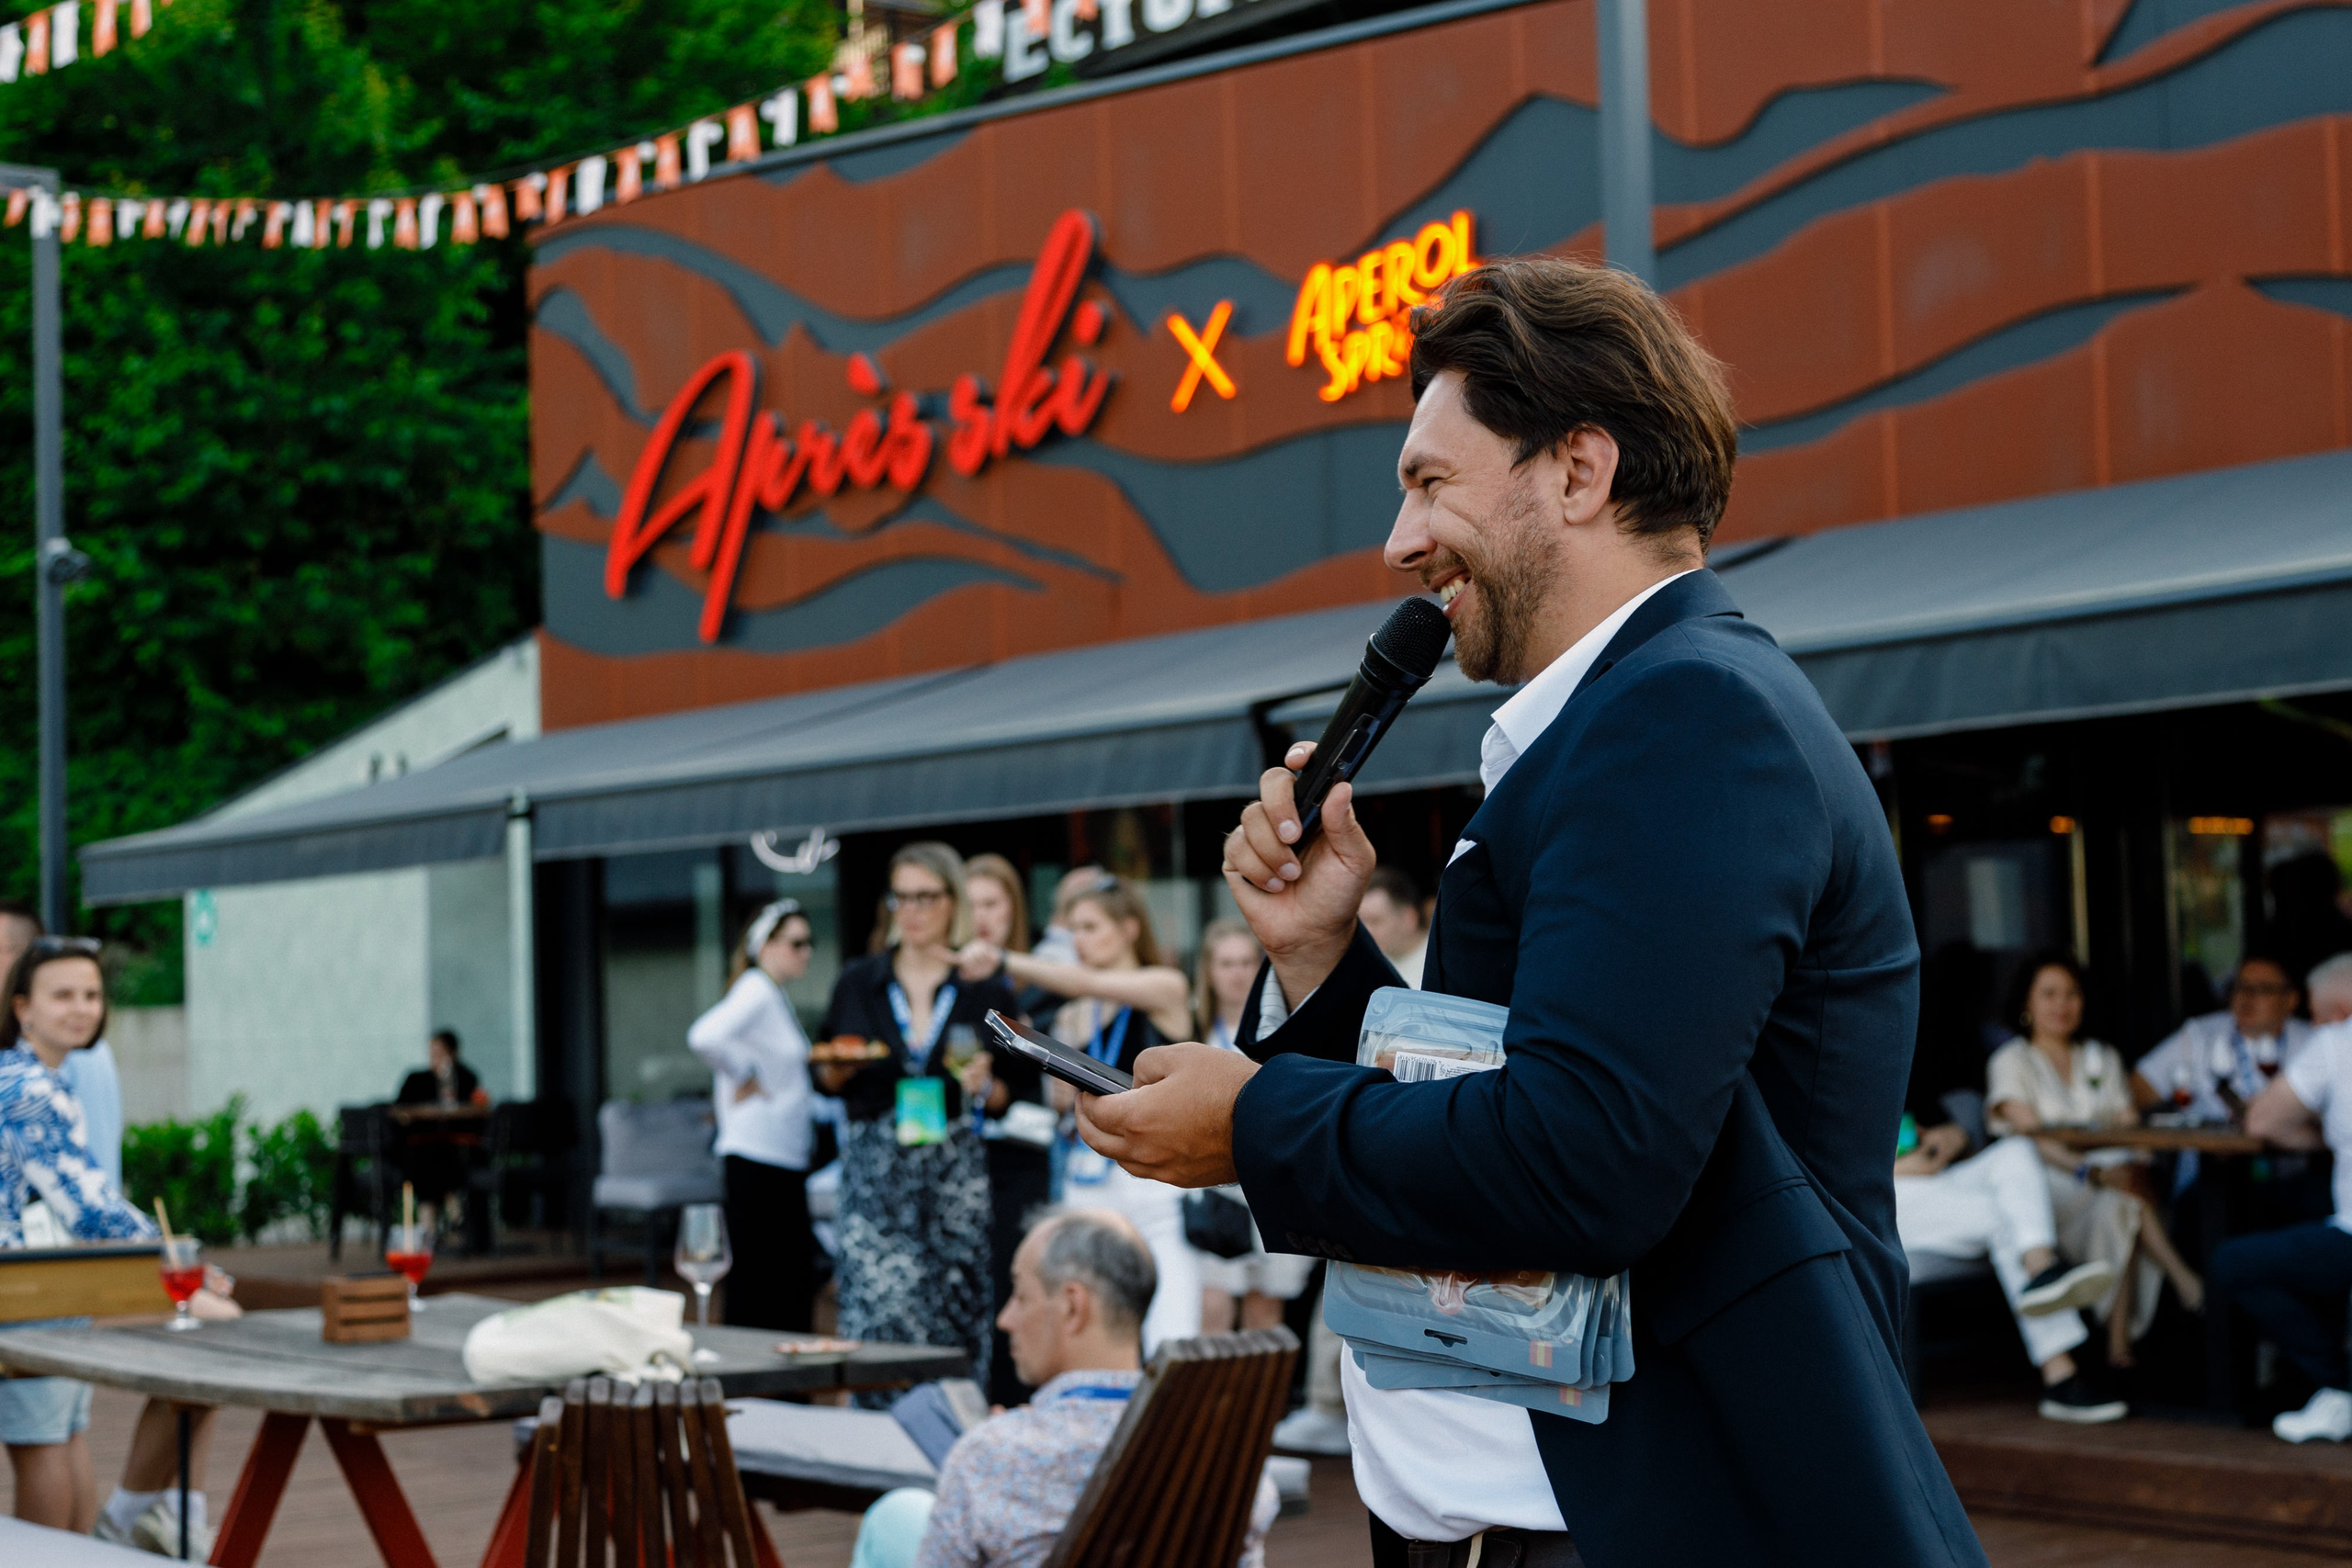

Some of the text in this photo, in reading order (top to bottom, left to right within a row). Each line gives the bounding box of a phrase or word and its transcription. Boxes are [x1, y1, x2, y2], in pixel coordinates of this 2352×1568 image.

[605, 208, 1110, 642] Après ski
[1286, 211, 1482, 367] APEROL
